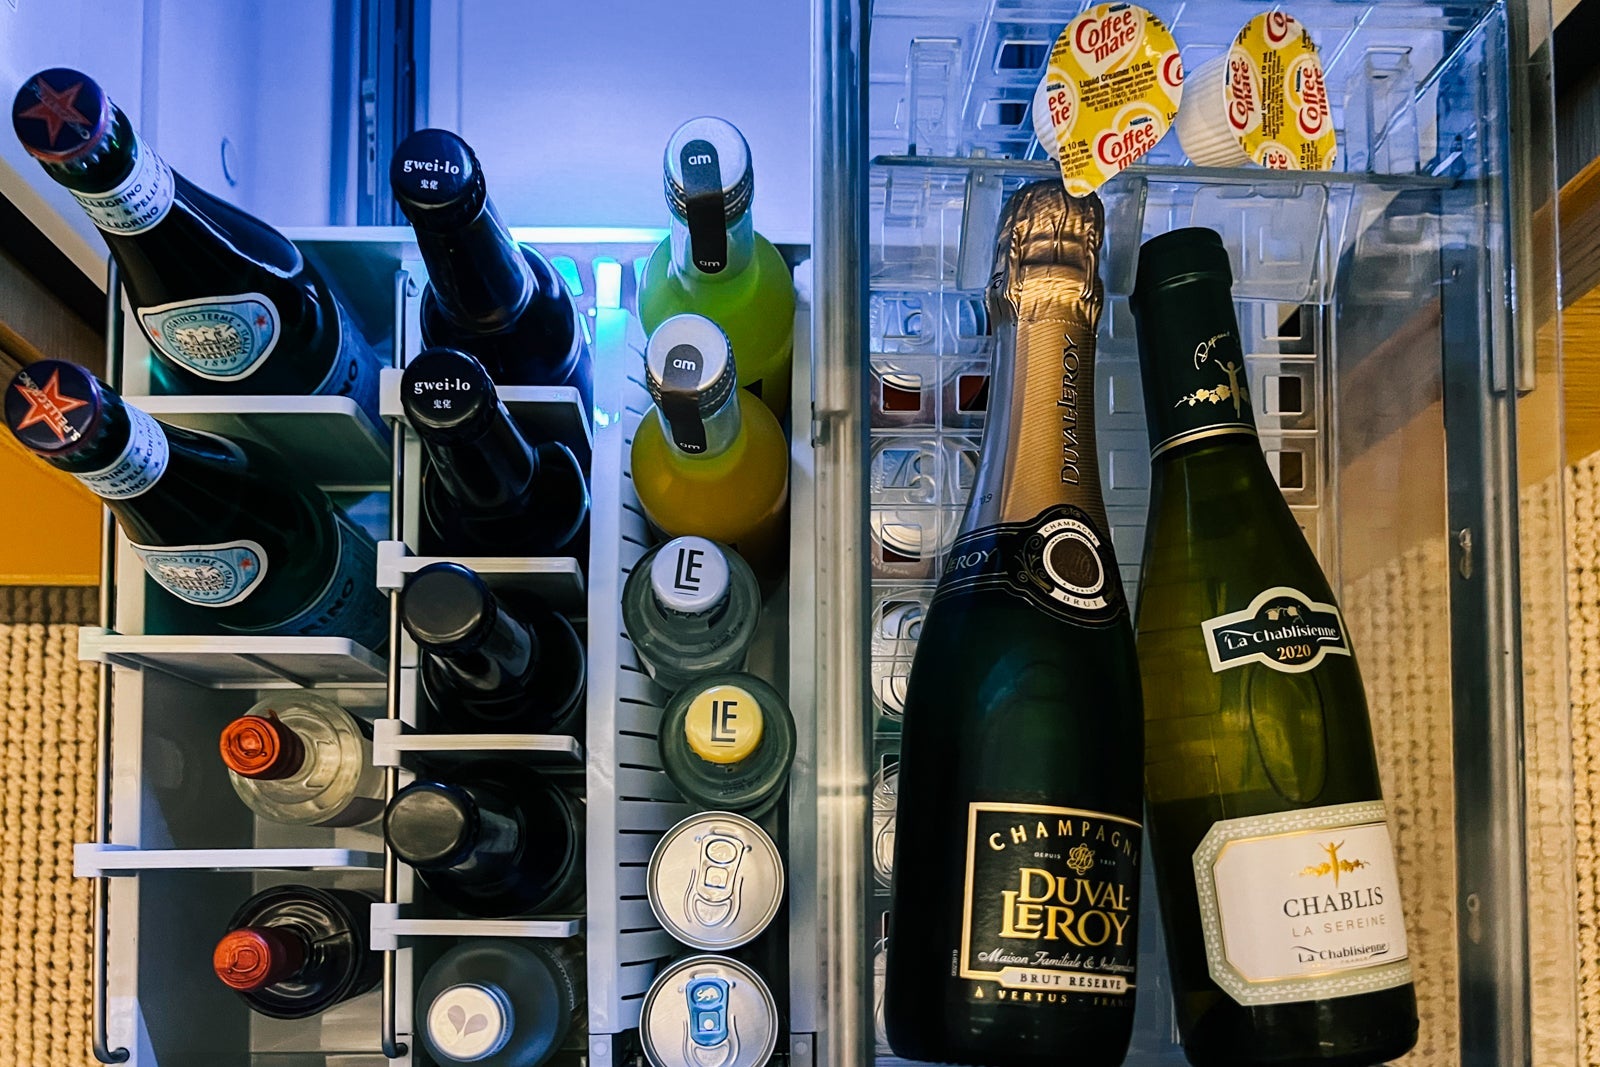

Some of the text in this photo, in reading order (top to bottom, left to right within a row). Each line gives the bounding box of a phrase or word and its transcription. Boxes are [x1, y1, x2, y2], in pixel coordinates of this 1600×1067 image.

[1075, 11, 1132, 54] Coffee
[1095, 25, 1136, 63] mate
[1131, 64, 1141, 74] 10
[1228, 61, 1249, 130] Coffee
[1241, 60, 1255, 112] mate
[1314, 67, 1328, 116] mate
[1299, 67, 1323, 134] Coffee
[1097, 123, 1154, 165] Coffee
[1118, 139, 1156, 171] mate
[688, 154, 712, 165] am
[201, 313, 235, 324] TERME
[672, 358, 697, 371] am
[1044, 520, 1097, 542] CHAMPAGNE
[182, 557, 217, 566] TERME
[673, 548, 704, 592] LE
[1062, 594, 1099, 608] BRUT
[1224, 624, 1336, 650] La Chablisienne
[1276, 643, 1311, 660] 2020
[711, 700, 738, 743] LE
[1033, 851, 1062, 860] DEPUIS
[1283, 886, 1384, 918] CHABLIS
[998, 890, 1131, 947] LEROY
[1292, 914, 1387, 938] LA SEREINE
[977, 947, 1029, 964] Maison
[1030, 951, 1082, 968] Familiale
[1083, 955, 1095, 969] &
[1298, 942, 1387, 963] La Chablisienne
[1020, 973, 1061, 985] BRUT
[998, 989, 1068, 1003] VERTUS
